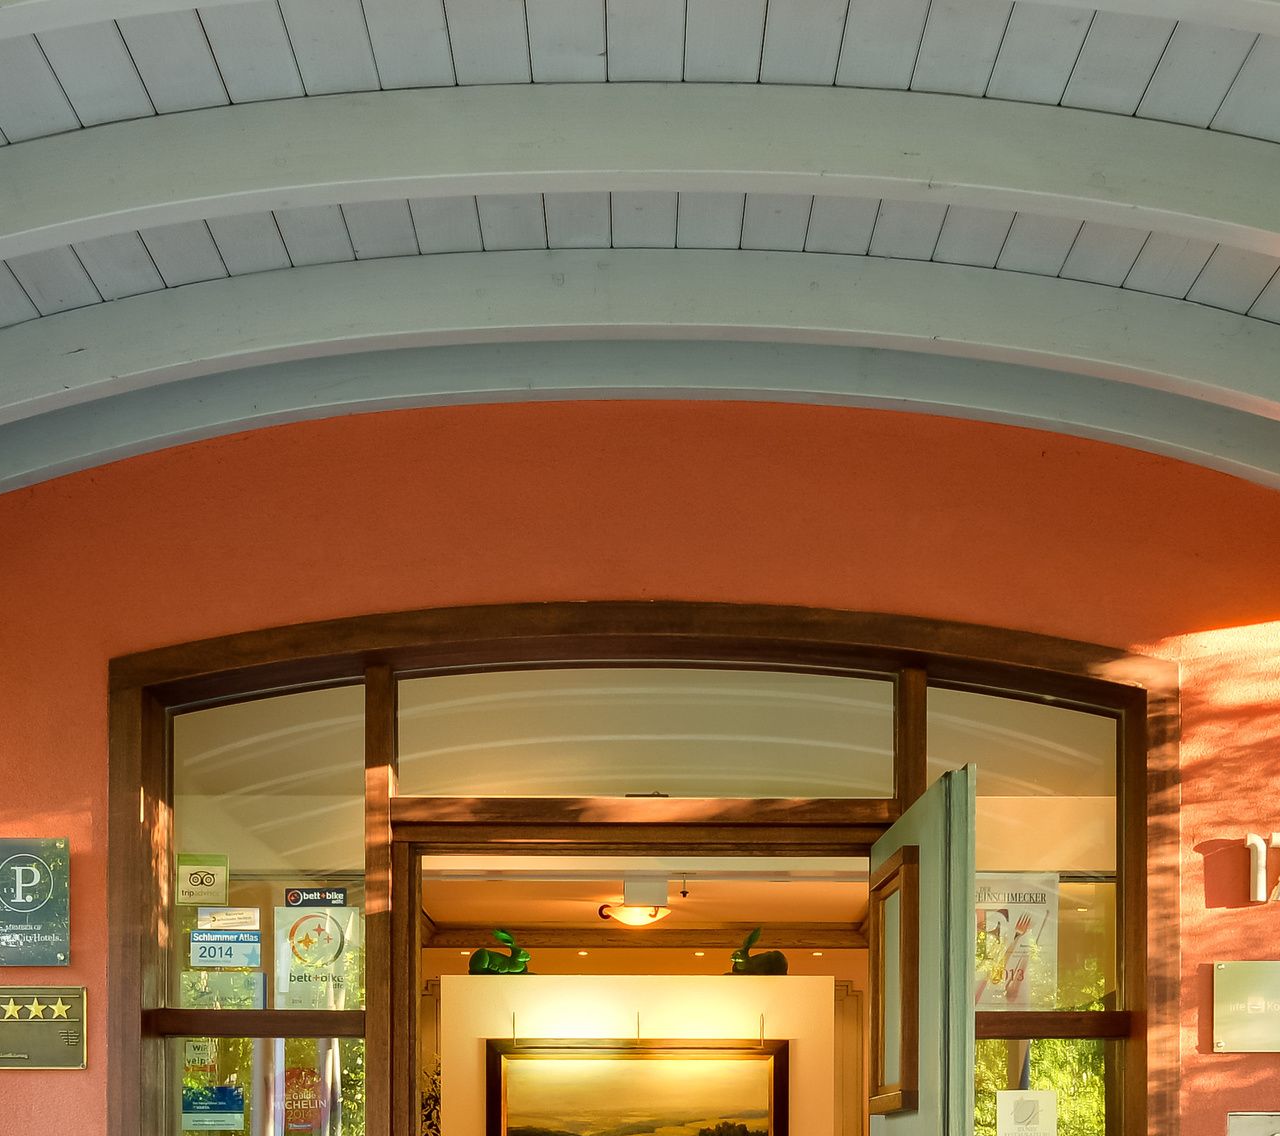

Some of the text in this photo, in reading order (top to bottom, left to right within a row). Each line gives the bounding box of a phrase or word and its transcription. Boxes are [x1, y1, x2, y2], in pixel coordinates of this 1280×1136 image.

[193, 932, 259, 942] Schlummer Atlas
[198, 945, 234, 959] 2014
